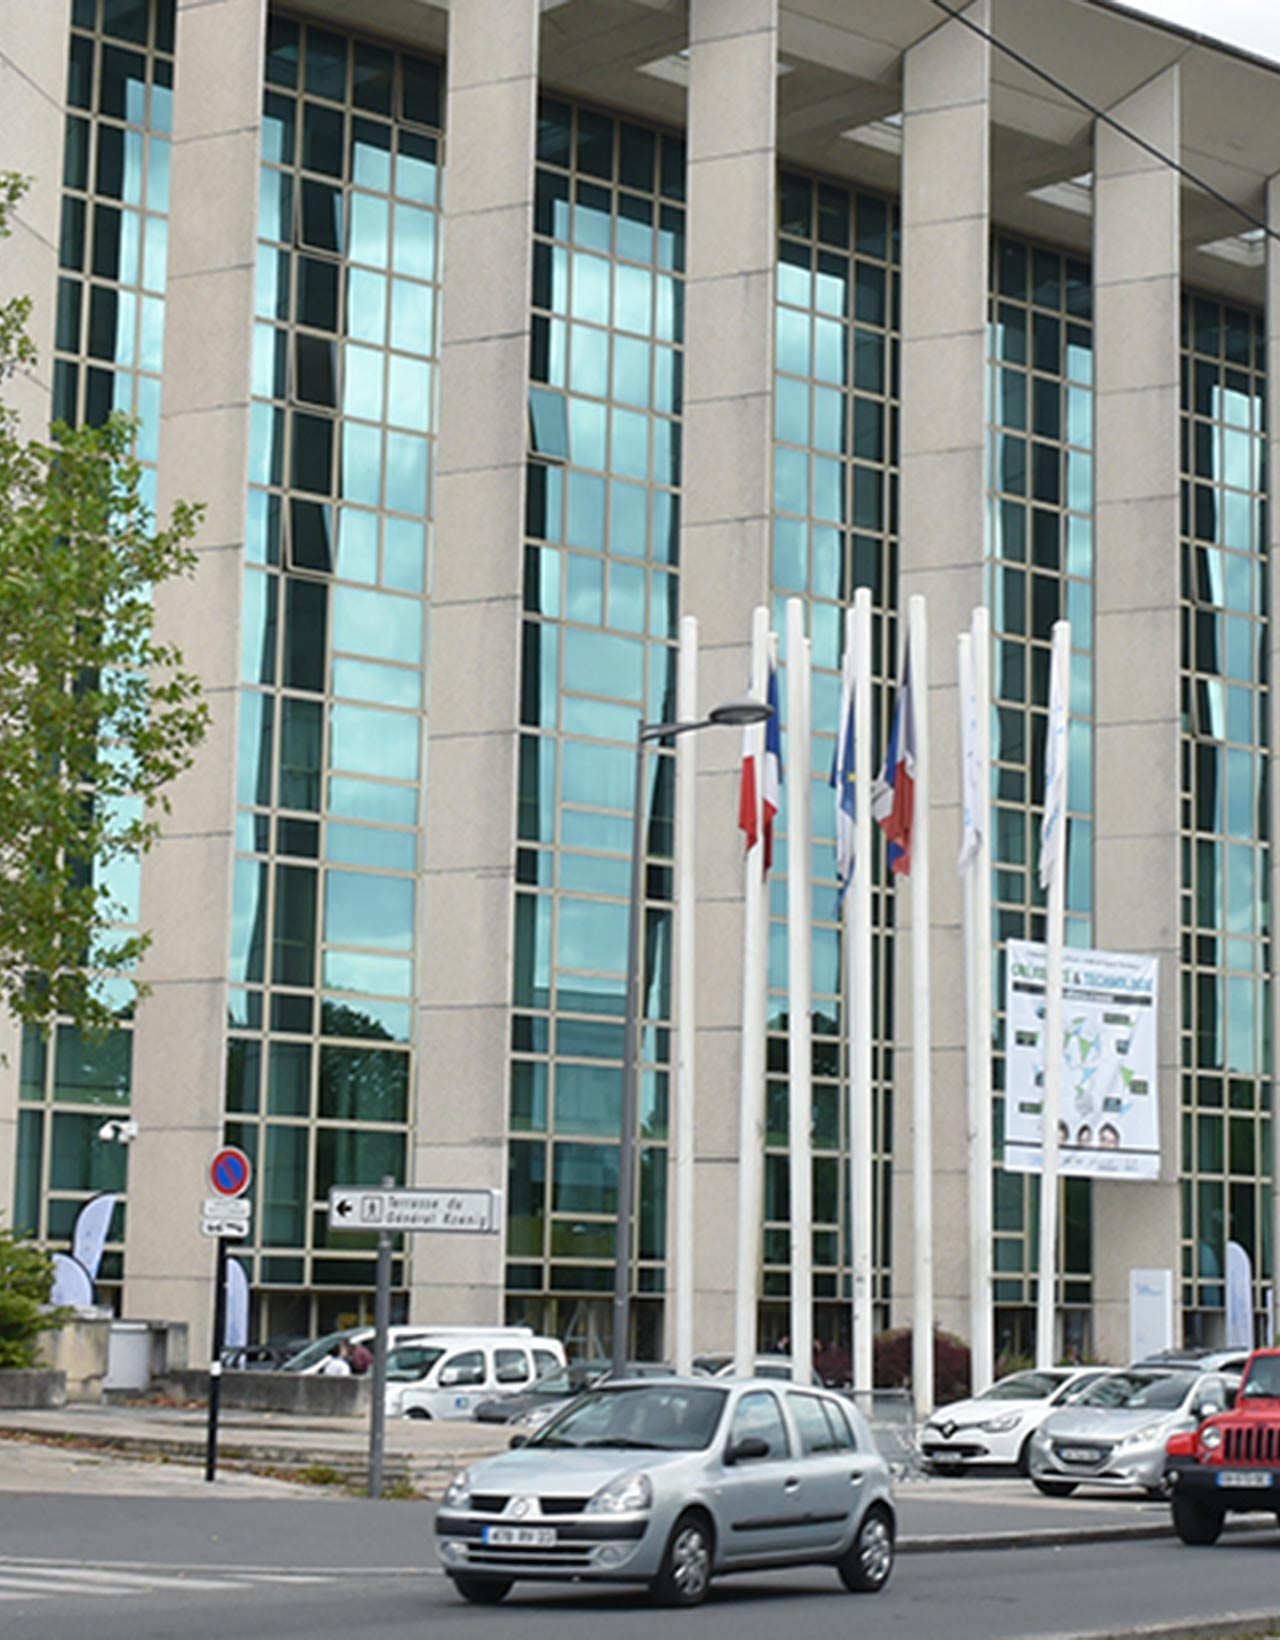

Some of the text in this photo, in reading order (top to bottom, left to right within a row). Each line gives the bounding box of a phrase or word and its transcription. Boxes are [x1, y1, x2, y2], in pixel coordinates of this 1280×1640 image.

[388, 1196, 463, 1210] Terrasse du
[387, 1211, 486, 1231] Général Koenig
